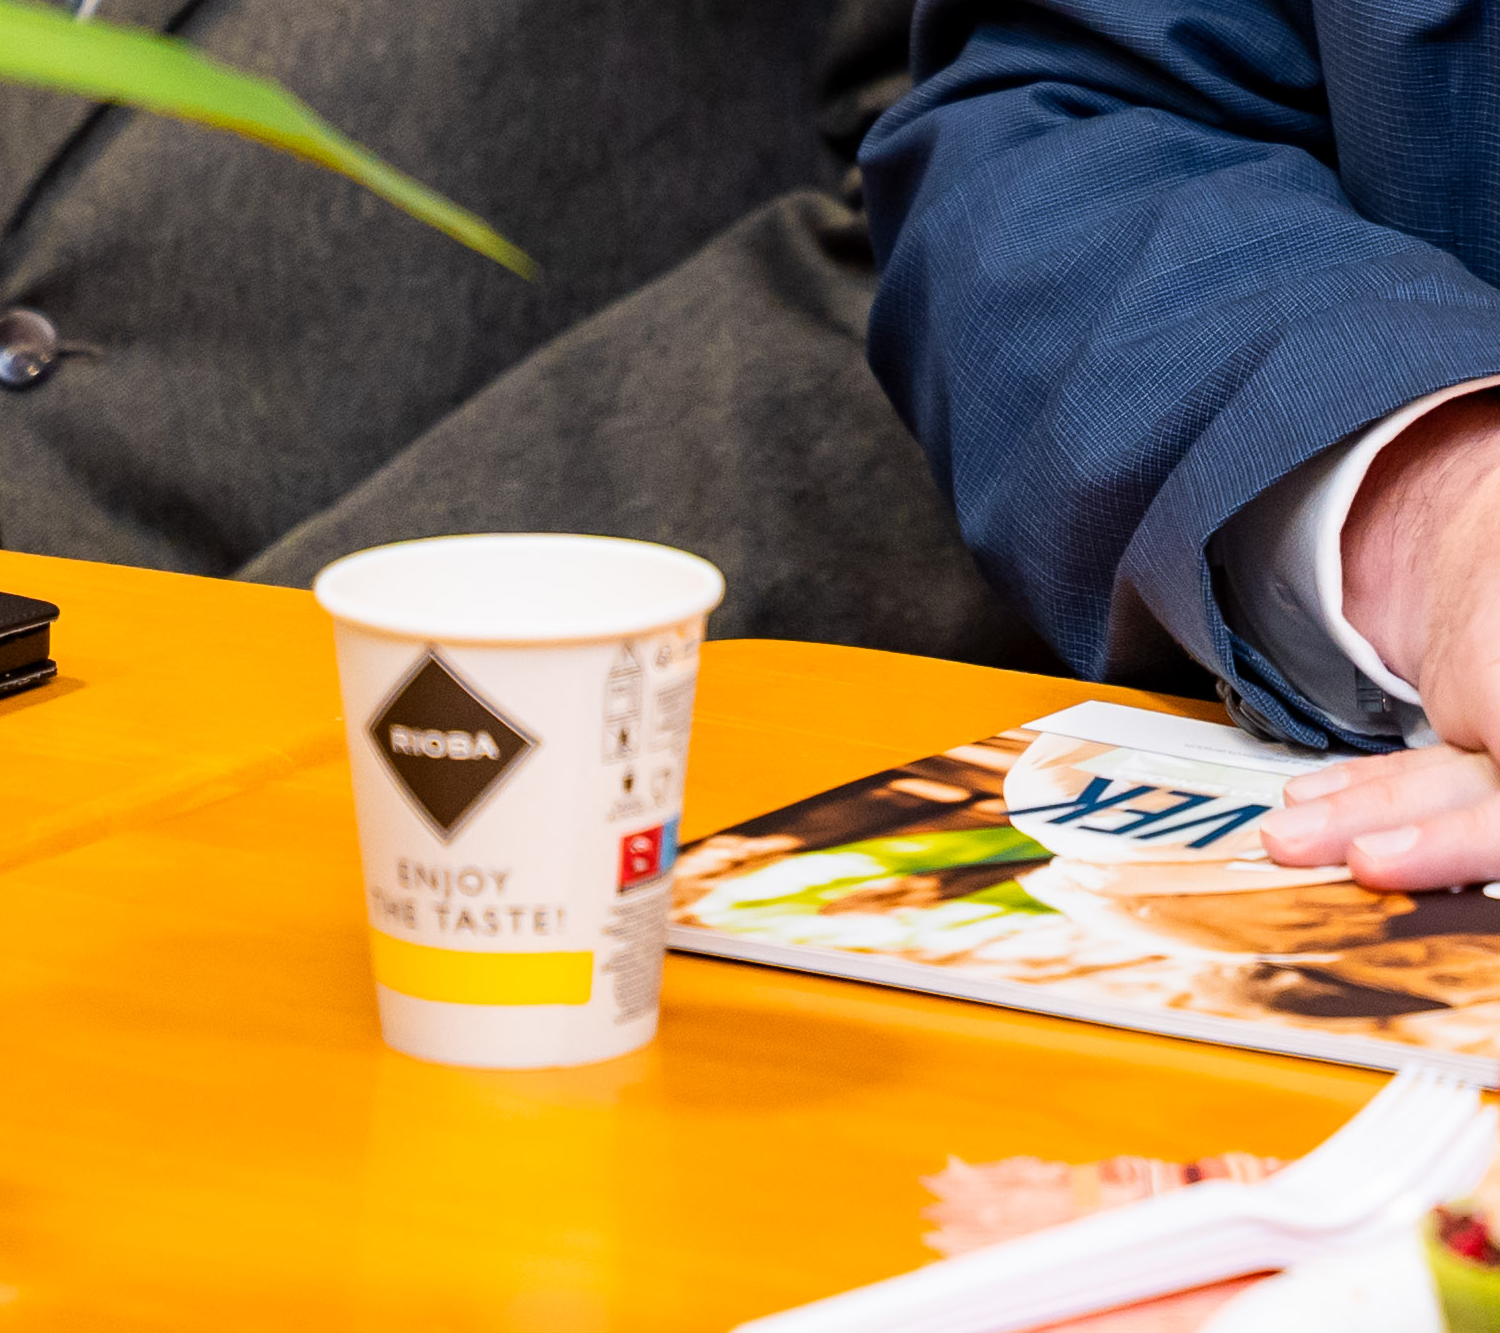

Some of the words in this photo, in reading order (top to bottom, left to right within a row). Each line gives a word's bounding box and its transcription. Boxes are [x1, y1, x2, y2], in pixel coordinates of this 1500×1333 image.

[390, 724, 499, 760] RIOBA
[1000, 777, 1272, 849] VEK
[398, 858, 511, 897] ENJOY
[435, 902, 565, 936] TASTE!
